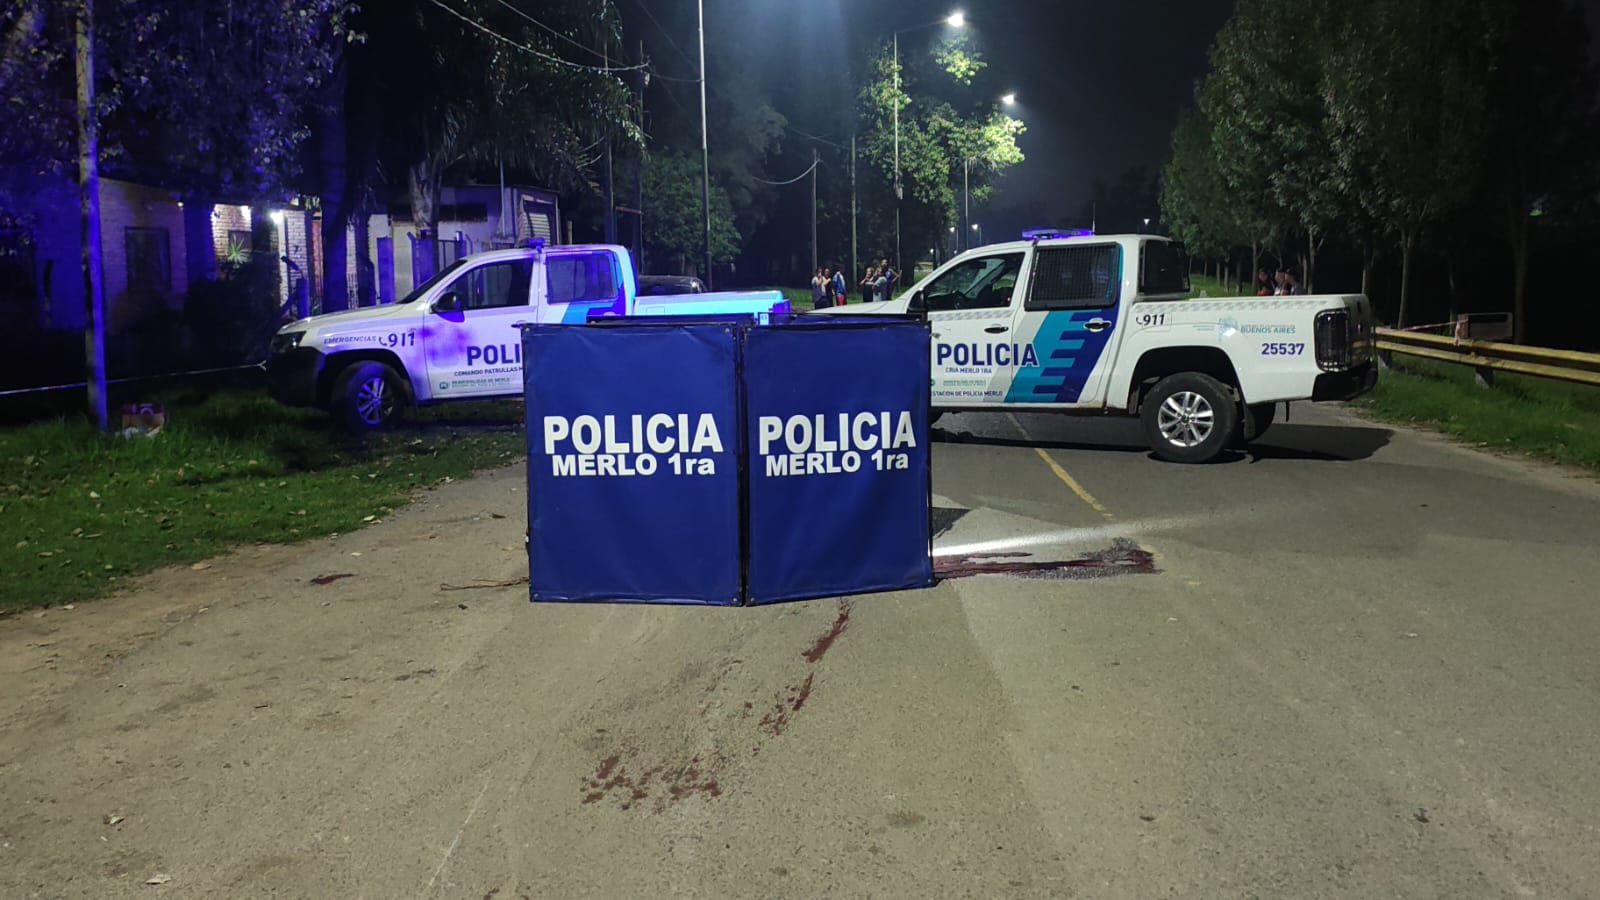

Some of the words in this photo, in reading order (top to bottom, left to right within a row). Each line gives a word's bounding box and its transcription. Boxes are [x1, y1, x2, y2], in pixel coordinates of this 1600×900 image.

[1143, 313, 1165, 326] 911
[323, 335, 377, 345] EMERGENCIAS
[388, 331, 415, 348] 911
[1261, 343, 1305, 355] 25537
[937, 343, 1039, 366] POLICIA
[454, 369, 483, 377] COMANDO
[484, 366, 518, 375] PATRULLAS
[543, 413, 724, 455] POLICIA
[759, 411, 917, 455] POLICIA
[552, 453, 658, 477] MERLO
[668, 453, 716, 475] 1ra
[766, 451, 861, 477] MERLO
[871, 450, 909, 471] 1ra
